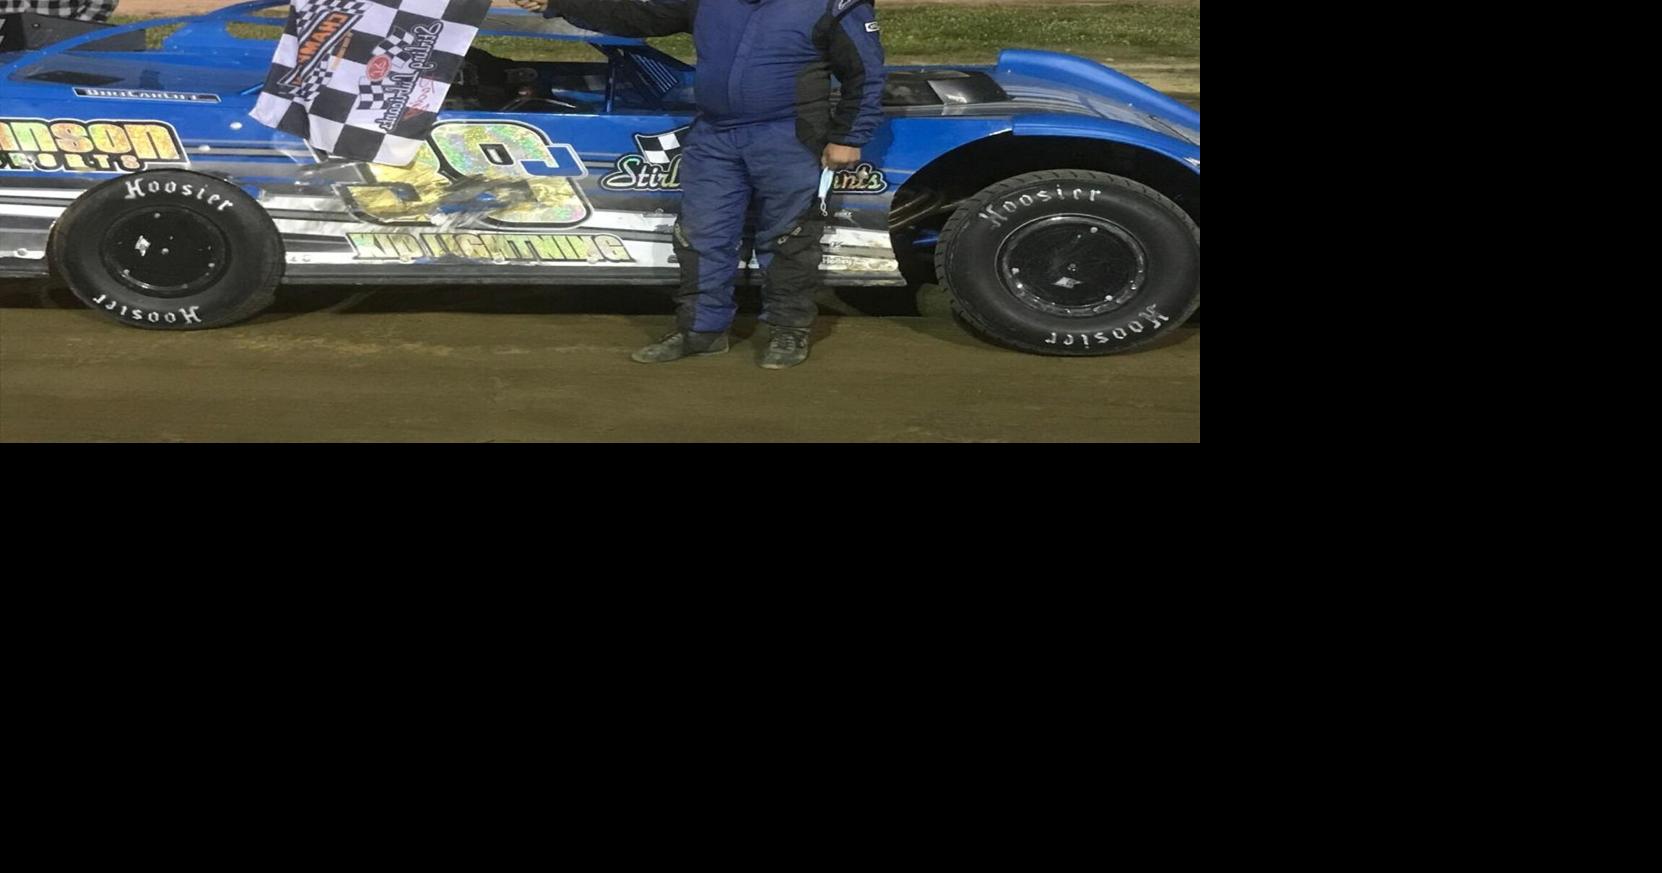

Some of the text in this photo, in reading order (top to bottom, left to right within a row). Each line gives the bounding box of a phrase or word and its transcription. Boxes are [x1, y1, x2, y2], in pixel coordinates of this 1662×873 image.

[0, 152, 142, 170] PORTS
[606, 158, 682, 188] Stirl
[124, 177, 233, 211] Hoosier
[979, 184, 1101, 228] Hoosier
[93, 294, 202, 324] Hoosier
[1045, 303, 1169, 349] Hoosier
